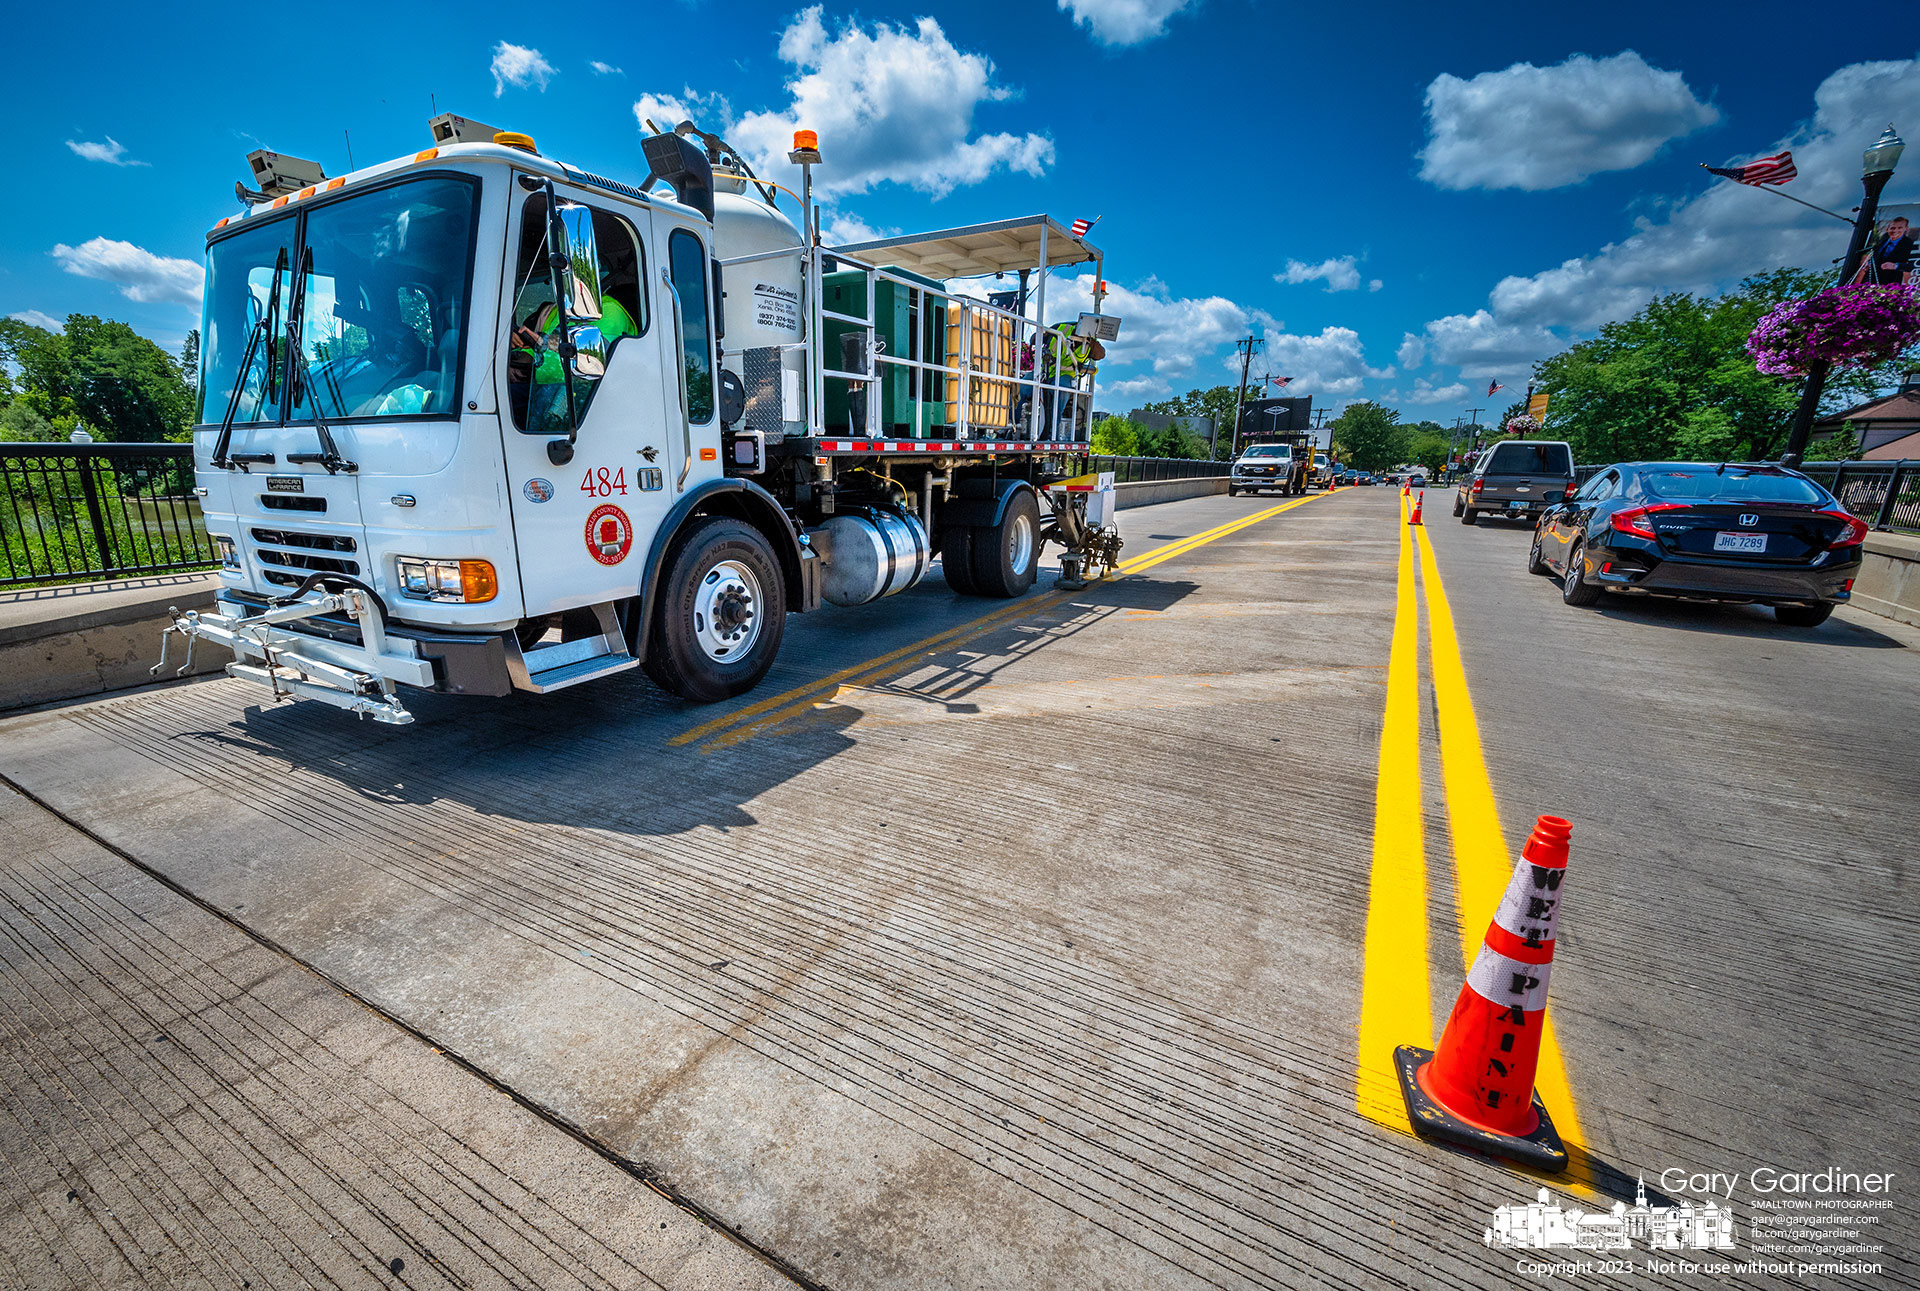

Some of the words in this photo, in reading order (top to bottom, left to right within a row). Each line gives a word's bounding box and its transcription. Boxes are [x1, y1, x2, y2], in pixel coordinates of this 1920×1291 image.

[759, 312, 774, 320] (937)
[580, 466, 628, 498] 484
[587, 512, 598, 545] FRANKLIN
[596, 506, 617, 516] COUNTY
[617, 511, 631, 540] ENGINEER
[598, 551, 625, 564] 525-3072
[1718, 537, 1736, 547] JHG
[1739, 537, 1763, 548] 7289
[1520, 865, 1566, 949] WET
[1480, 972, 1540, 1110] PAINT
